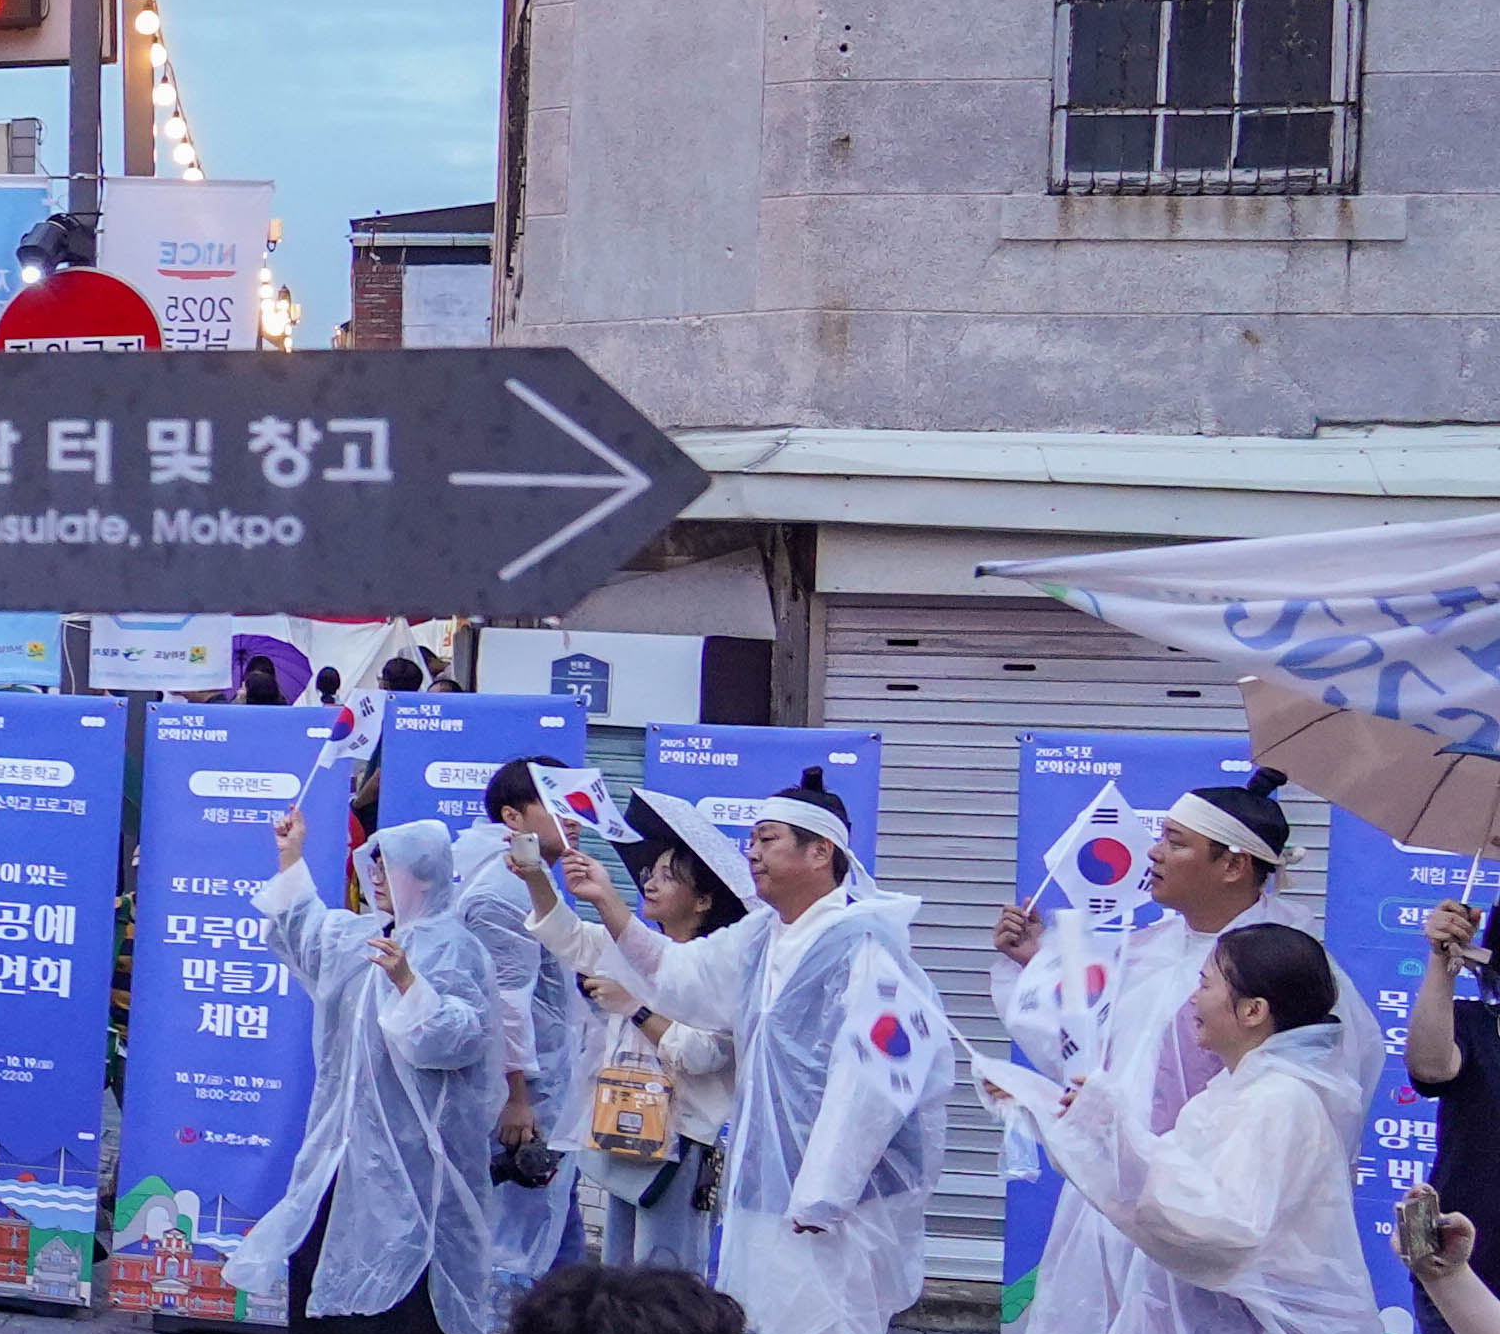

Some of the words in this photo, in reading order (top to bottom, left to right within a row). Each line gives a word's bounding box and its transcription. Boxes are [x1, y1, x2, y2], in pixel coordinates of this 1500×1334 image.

[45, 418, 113, 485] 터
[145, 417, 214, 485] 및
[246, 415, 394, 489] 창고
[152, 508, 302, 550] Mokpo
[419, 704, 442, 717] 목포
[182, 715, 204, 727] 목포
[659, 738, 684, 748] 2025
[687, 737, 712, 749] 목포
[1036, 747, 1062, 756] 2025
[1065, 746, 1093, 759] 목포
[217, 776, 273, 793] 유유랜드
[34, 798, 87, 815] 프로그램
[436, 800, 463, 816] 체험
[202, 808, 230, 824] 체험
[26, 864, 69, 887] 있는
[1409, 866, 1446, 885] 체험
[171, 877, 188, 892] 또
[191, 878, 229, 896] 다른
[182, 958, 289, 996] 만들기
[197, 1002, 269, 1039] 체험
